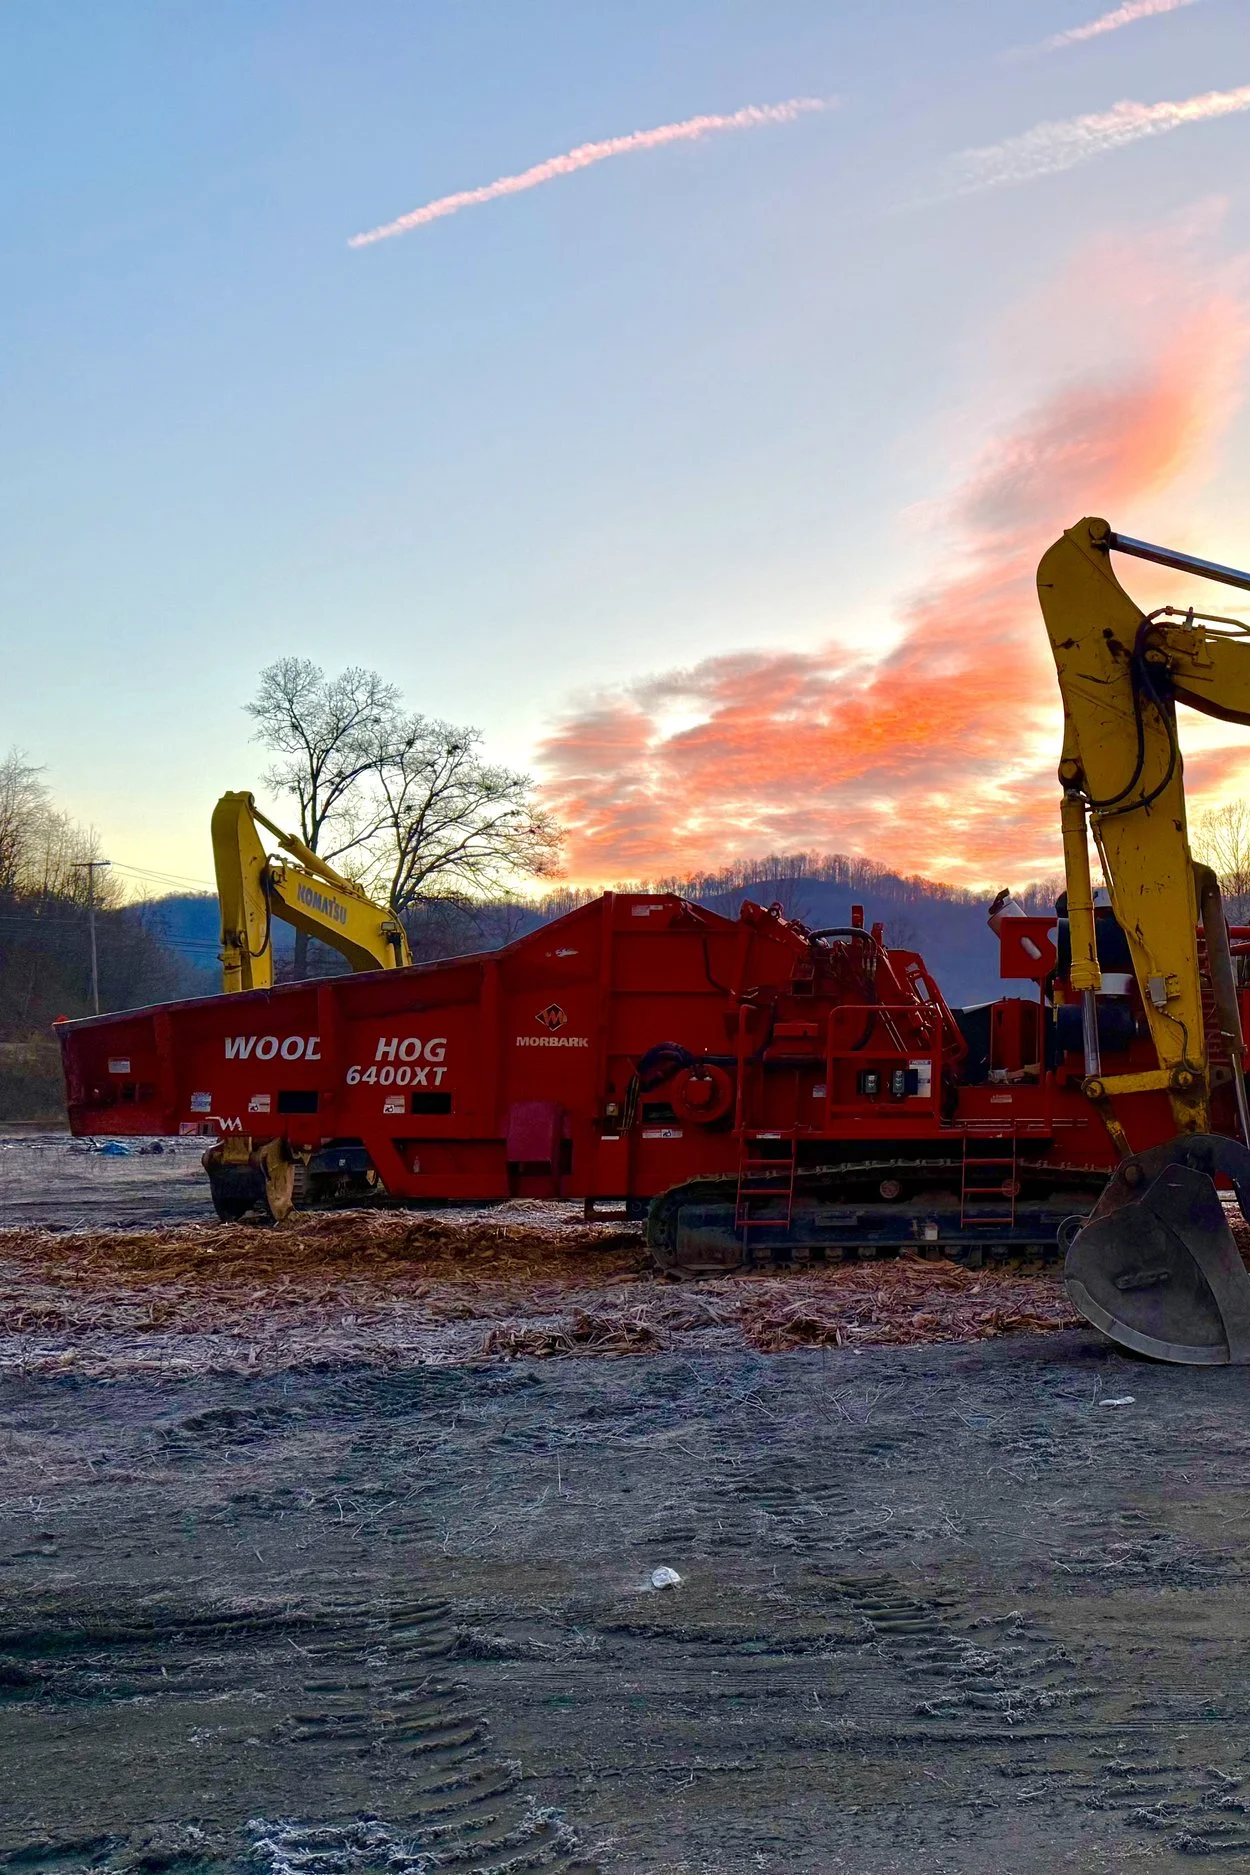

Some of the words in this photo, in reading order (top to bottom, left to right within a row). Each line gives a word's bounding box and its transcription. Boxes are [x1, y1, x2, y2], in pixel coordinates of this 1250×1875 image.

[297, 882, 348, 925] KOMATSU
[224, 1036, 321, 1060] WOOD
[374, 1037, 447, 1062] HOG
[516, 1036, 589, 1047] MORBARK
[346, 1065, 447, 1086] 6400XT
